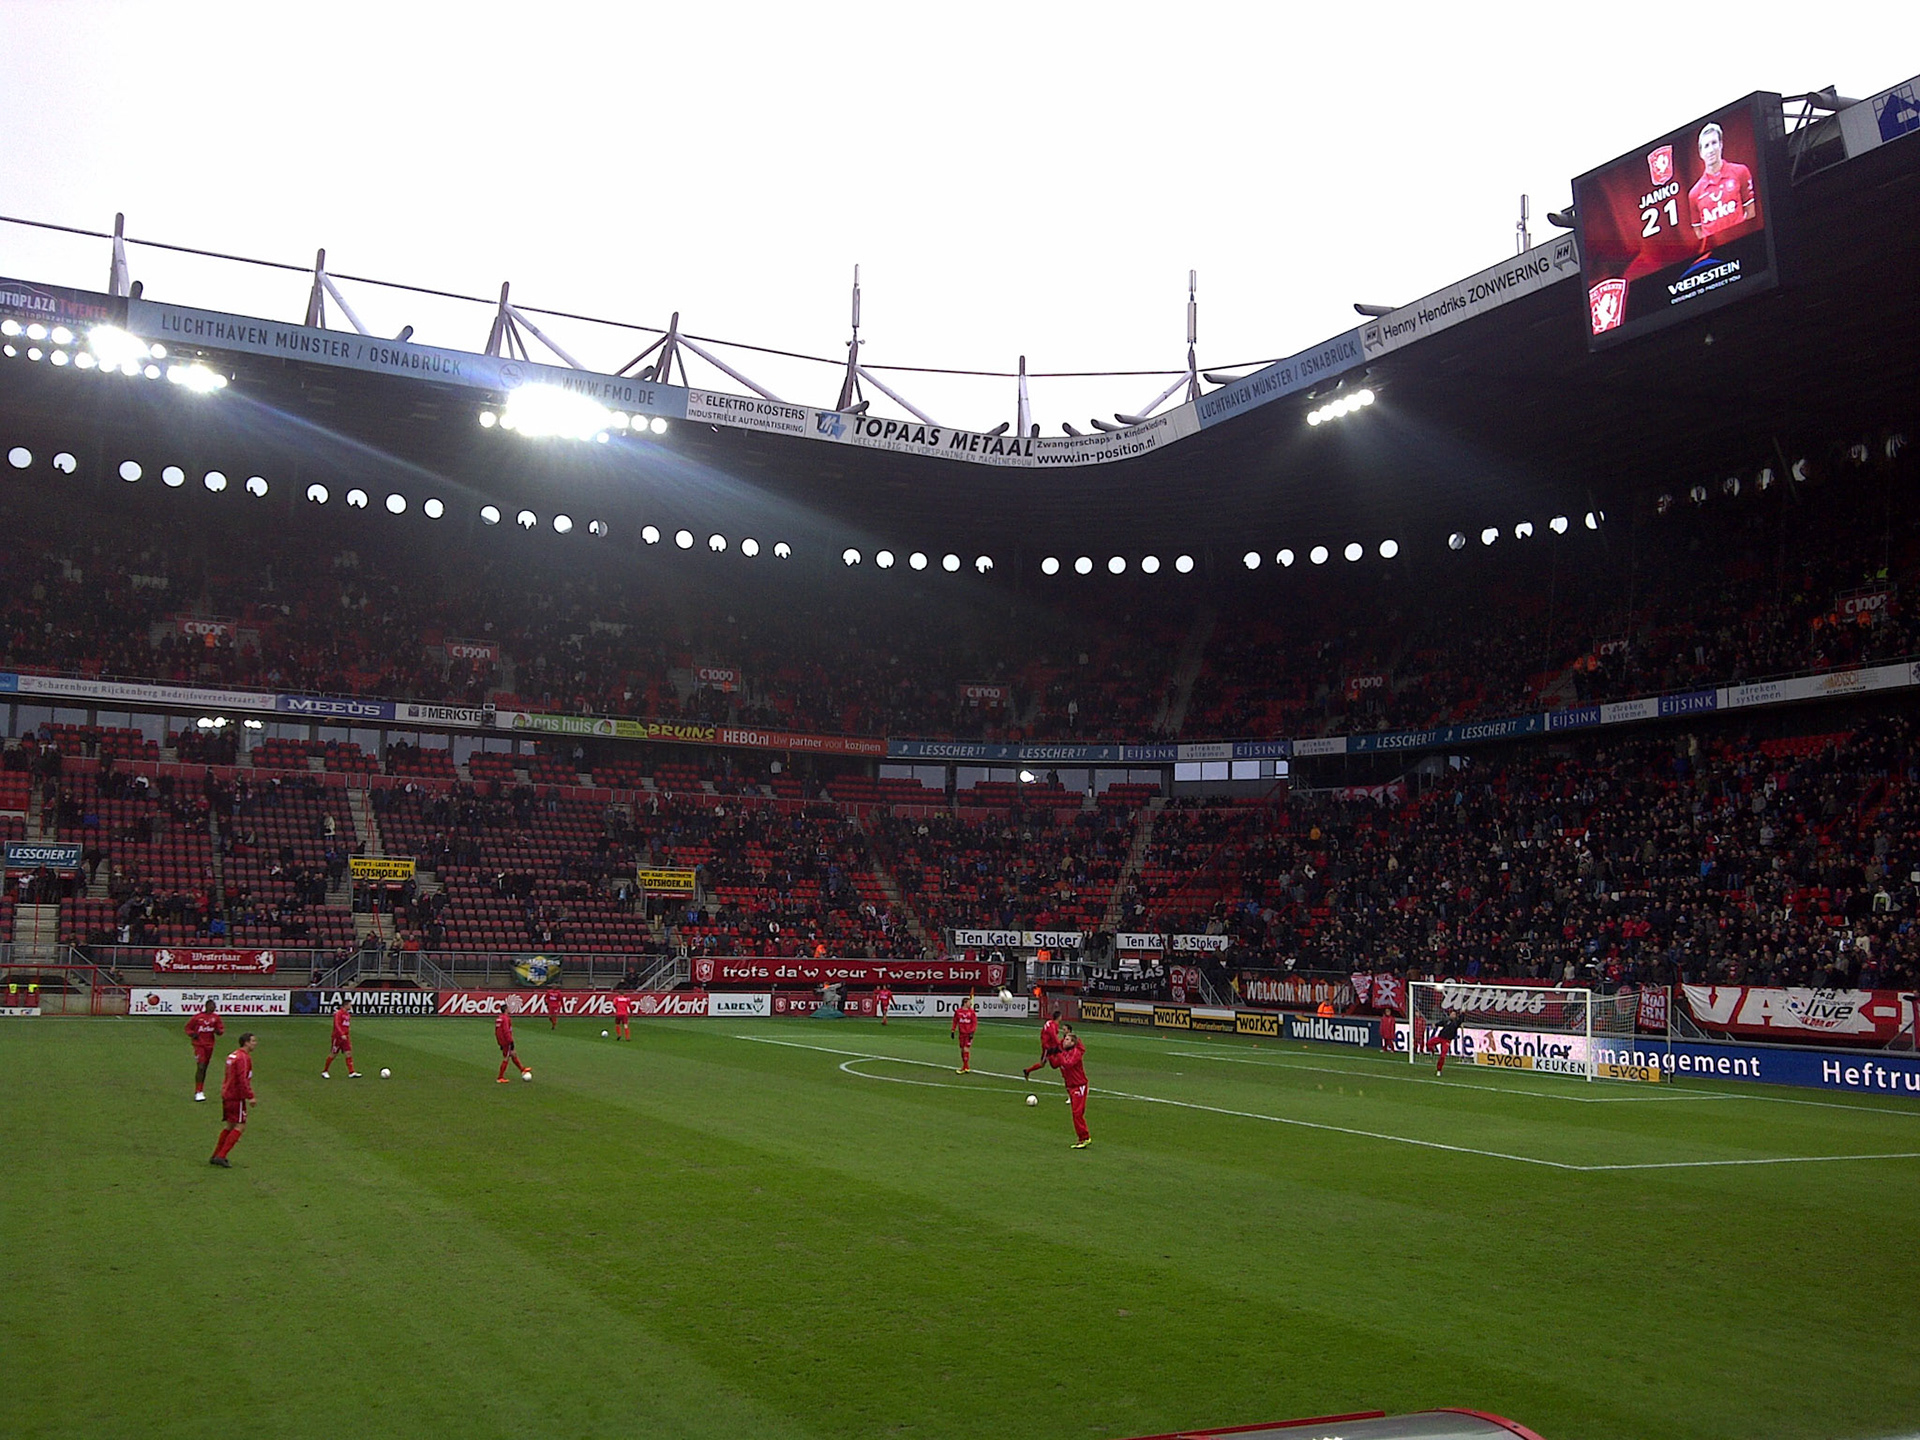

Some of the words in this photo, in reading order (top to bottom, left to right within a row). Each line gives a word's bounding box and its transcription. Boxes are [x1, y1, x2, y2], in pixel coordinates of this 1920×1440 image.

[1638, 182, 1680, 209] JANKO
[1640, 199, 1679, 238] 21
[1702, 200, 1737, 224] Arke
[1667, 260, 1741, 295] VREDESTEIN
[1382, 318, 1416, 340] Henny
[1418, 296, 1467, 325] Hendriks
[1467, 257, 1550, 304] ZONWERING
[59, 298, 108, 319] TWENTE
[162, 313, 267, 346] LUCHTHAVEN
[275, 331, 350, 359] MÜNSTER
[369, 347, 461, 376] OSNABRÜCK
[1200, 391, 1251, 420] LUCHTHAVEN
[1252, 371, 1292, 397] MÜNSTER
[1301, 341, 1358, 378] OSNABRÜCK
[562, 376, 655, 405] WWW.FMO.DE
[706, 395, 755, 413] ELEKTRO
[756, 403, 806, 421] KOSTERS
[738, 416, 804, 433] AUTOMATISERING
[1036, 431, 1113, 449] Zwangerschaps-
[1124, 417, 1168, 440] Kinderkleding
[855, 416, 941, 447] TOPAAS
[949, 431, 1035, 458] METAAL
[1036, 436, 1156, 465] www.in-position.nl
[562, 716, 593, 733] huis
[648, 722, 715, 740] BRUINS
[1461, 724, 1507, 740] LESSCHER
[722, 730, 769, 746] HEBO.nl
[789, 738, 822, 749] partner
[844, 739, 881, 753] kozijnen
[1376, 734, 1428, 749] LESSCHER
[920, 745, 974, 758] LESSCHER
[1020, 747, 1074, 759] LESSCHER
[9, 848, 65, 860] LESSCHER
[65, 849, 78, 858] IT
[643, 879, 693, 888] LOTSHOEK.NL
[960, 931, 982, 944] Ten
[986, 932, 1017, 945] Kate
[1033, 933, 1077, 946] Stoker
[1125, 935, 1144, 947] Ten
[1148, 936, 1179, 948] Kae
[1190, 937, 1223, 950] Stoker
[722, 966, 769, 978] trots
[825, 968, 868, 979] veur
[872, 967, 934, 980] Twente
[949, 967, 982, 981] bint
[135, 1001, 148, 1012] ik
[160, 1001, 173, 1012] ik
[182, 993, 205, 1003] Baby
[223, 993, 286, 1001] Kinderwinkel
[319, 991, 435, 1006] LAMMERINK
[438, 993, 506, 1014] Media
[519, 993, 578, 1014] Mkt
[577, 994, 641, 1014] Mea
[653, 995, 708, 1014] Markt
[717, 1002, 753, 1011] LAREX
[790, 1001, 805, 1010] FC
[181, 1004, 285, 1013] WW.IKENIK.NL
[319, 1005, 434, 1014] INSALLATIEGROEP
[983, 1001, 1026, 1014] bouwgroep
[1291, 1018, 1369, 1048] wildkamp
[1427, 1027, 1475, 1056] Kte
[1500, 1034, 1572, 1061] Stoker
[1487, 1053, 1522, 1068] svea
[1535, 1059, 1592, 1076] KEUKEN
[1597, 1048, 1761, 1078] management
[1608, 1064, 1649, 1081] svea
